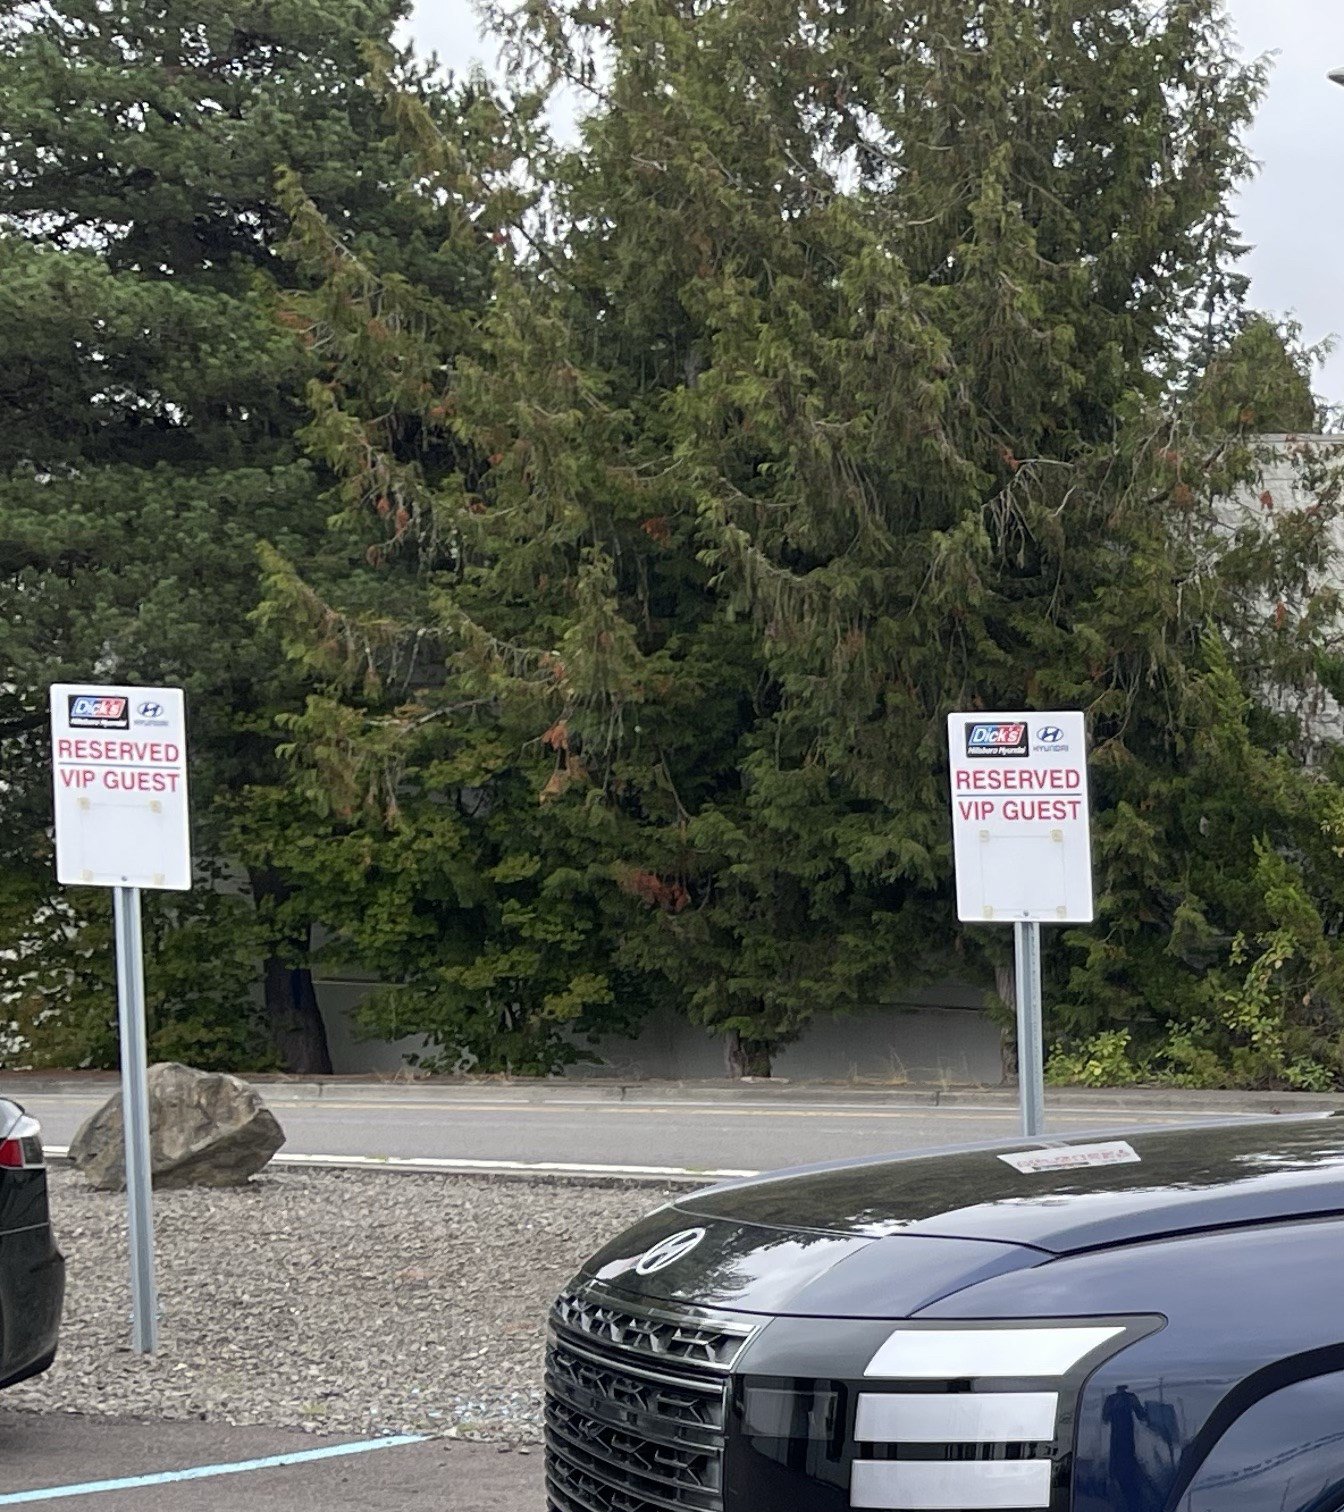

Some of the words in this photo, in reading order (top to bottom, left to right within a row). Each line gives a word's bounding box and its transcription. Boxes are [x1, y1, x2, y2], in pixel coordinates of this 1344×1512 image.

[58, 739, 180, 762] RESERVED
[60, 769, 96, 788] VIP
[103, 771, 180, 792] GUEST
[956, 769, 1080, 789] RESERVED
[958, 801, 995, 820] VIP
[1003, 800, 1081, 820] GUEST
